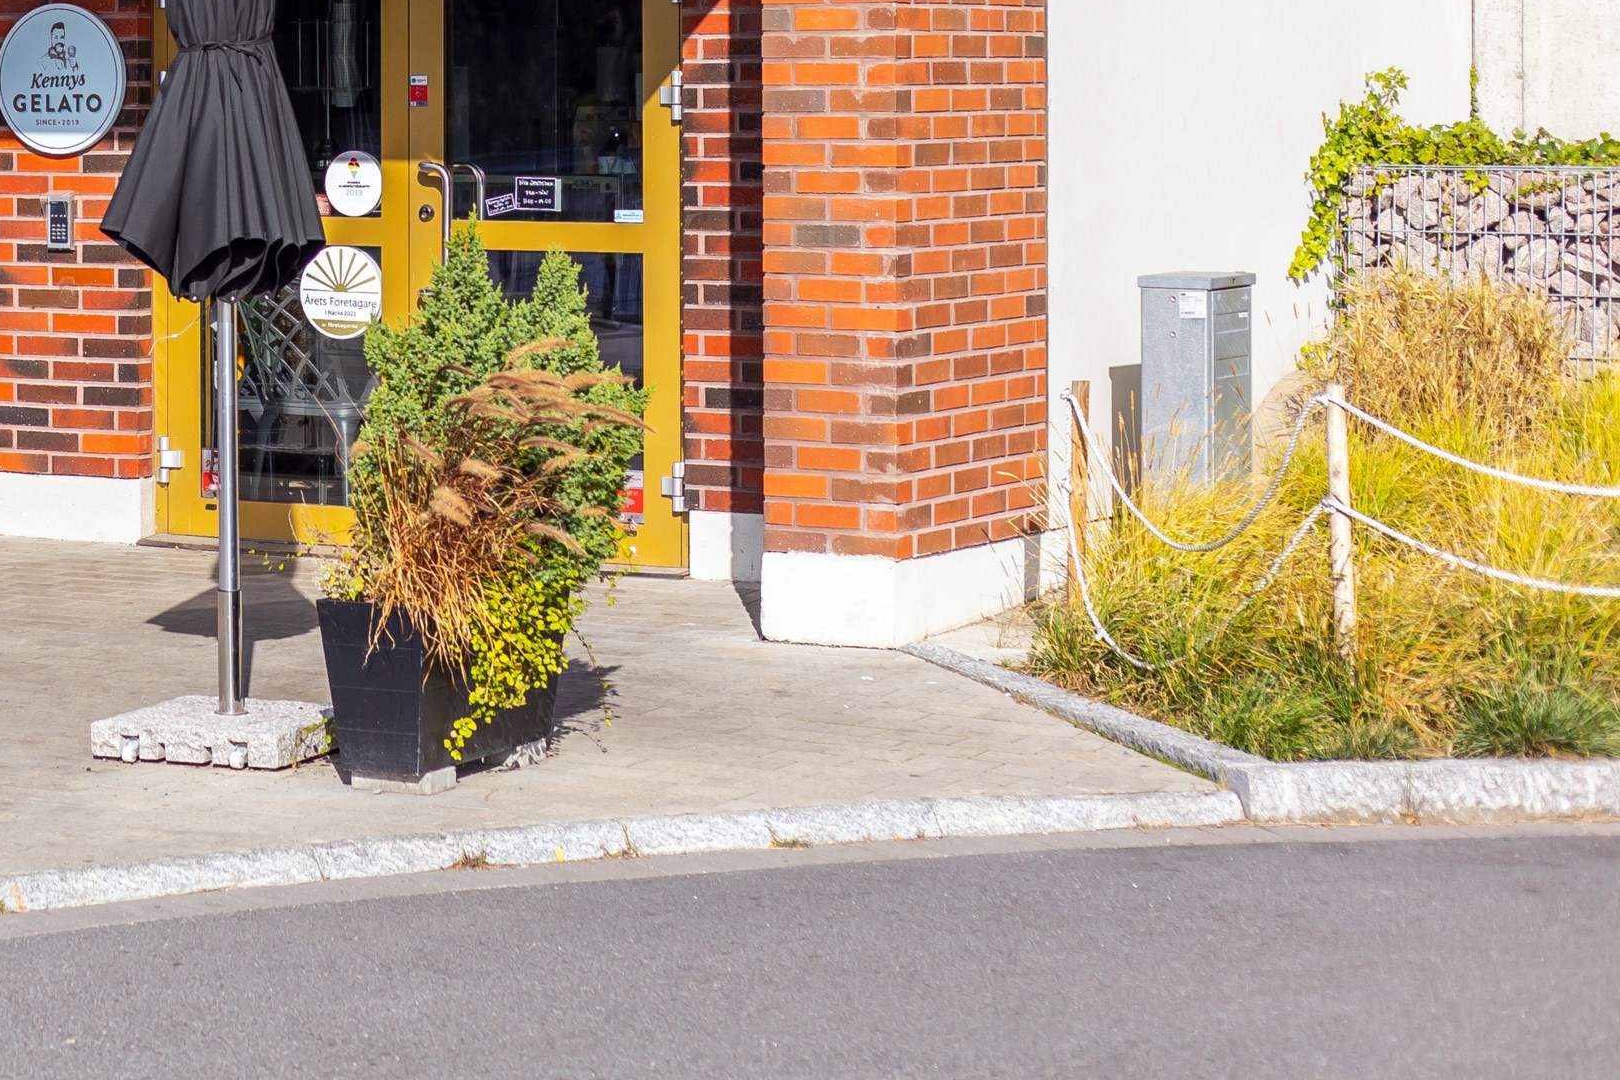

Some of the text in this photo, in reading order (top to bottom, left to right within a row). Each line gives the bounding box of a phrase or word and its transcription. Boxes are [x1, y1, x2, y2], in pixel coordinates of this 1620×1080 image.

[30, 72, 86, 91] Kennys
[12, 93, 103, 113] GELATO
[304, 293, 377, 310] Årets Företagare
